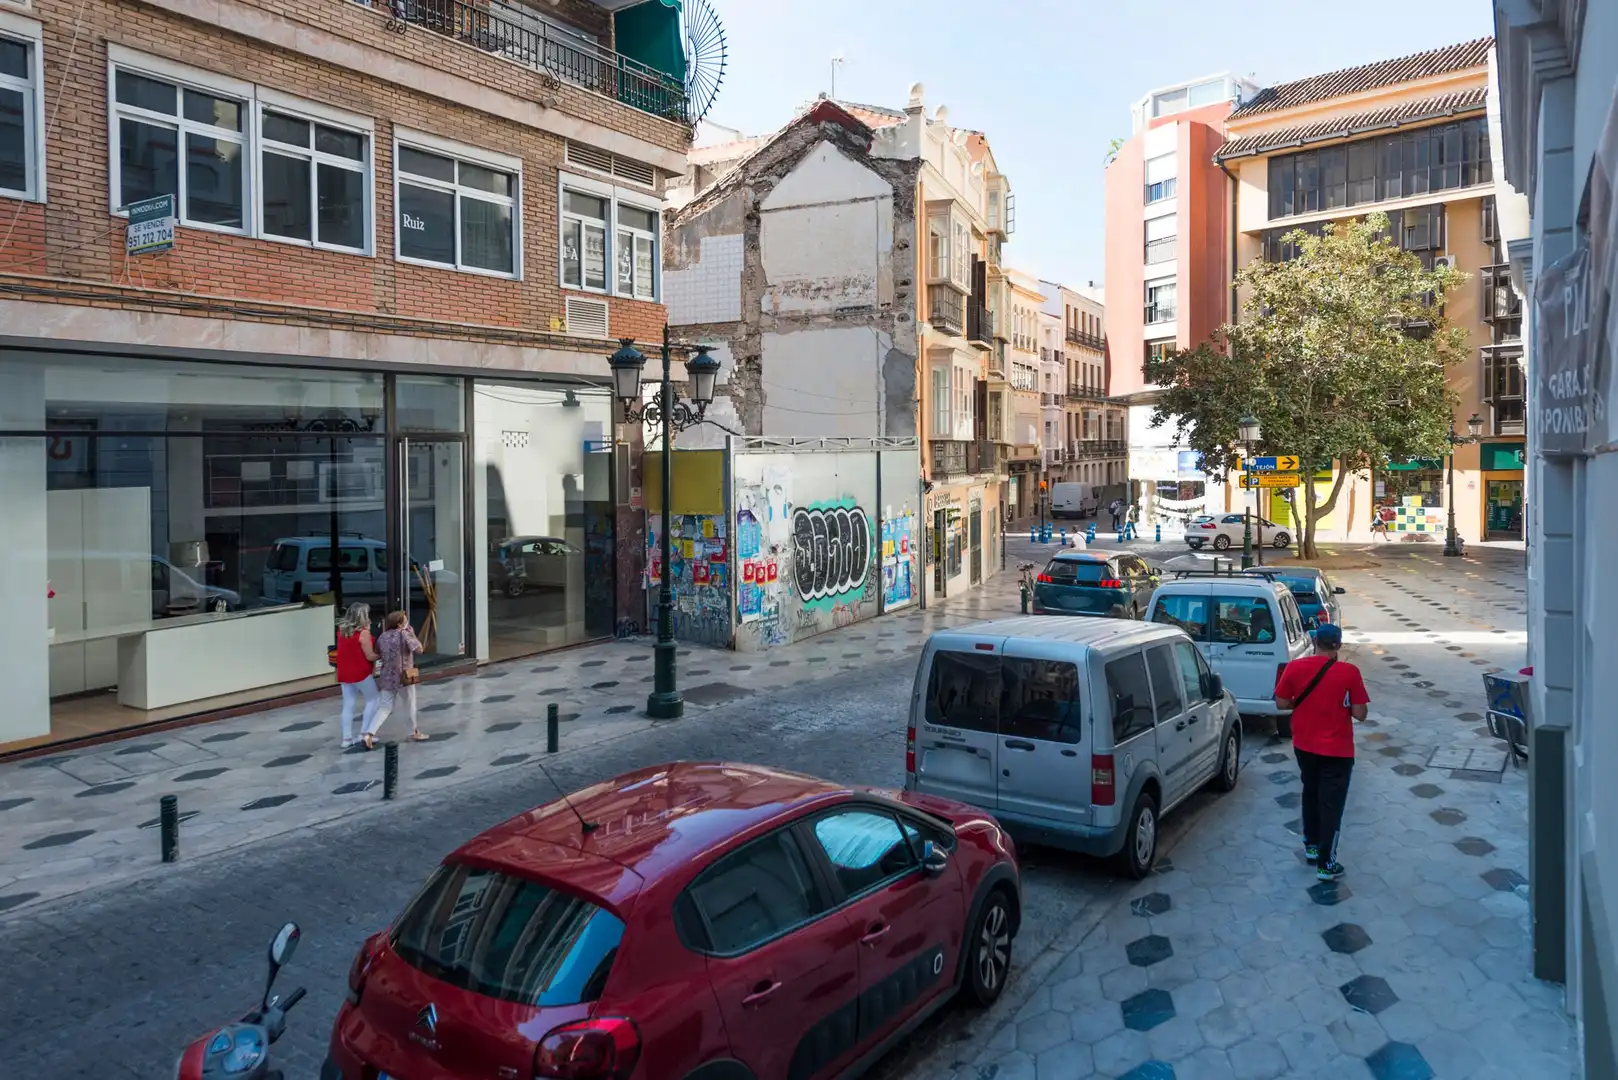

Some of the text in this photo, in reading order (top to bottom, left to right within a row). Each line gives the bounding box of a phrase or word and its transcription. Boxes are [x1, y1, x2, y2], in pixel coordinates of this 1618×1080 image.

[134, 219, 165, 232] SE VENDE
[403, 213, 425, 231] Ruiz
[128, 228, 173, 248] 951 212 704
